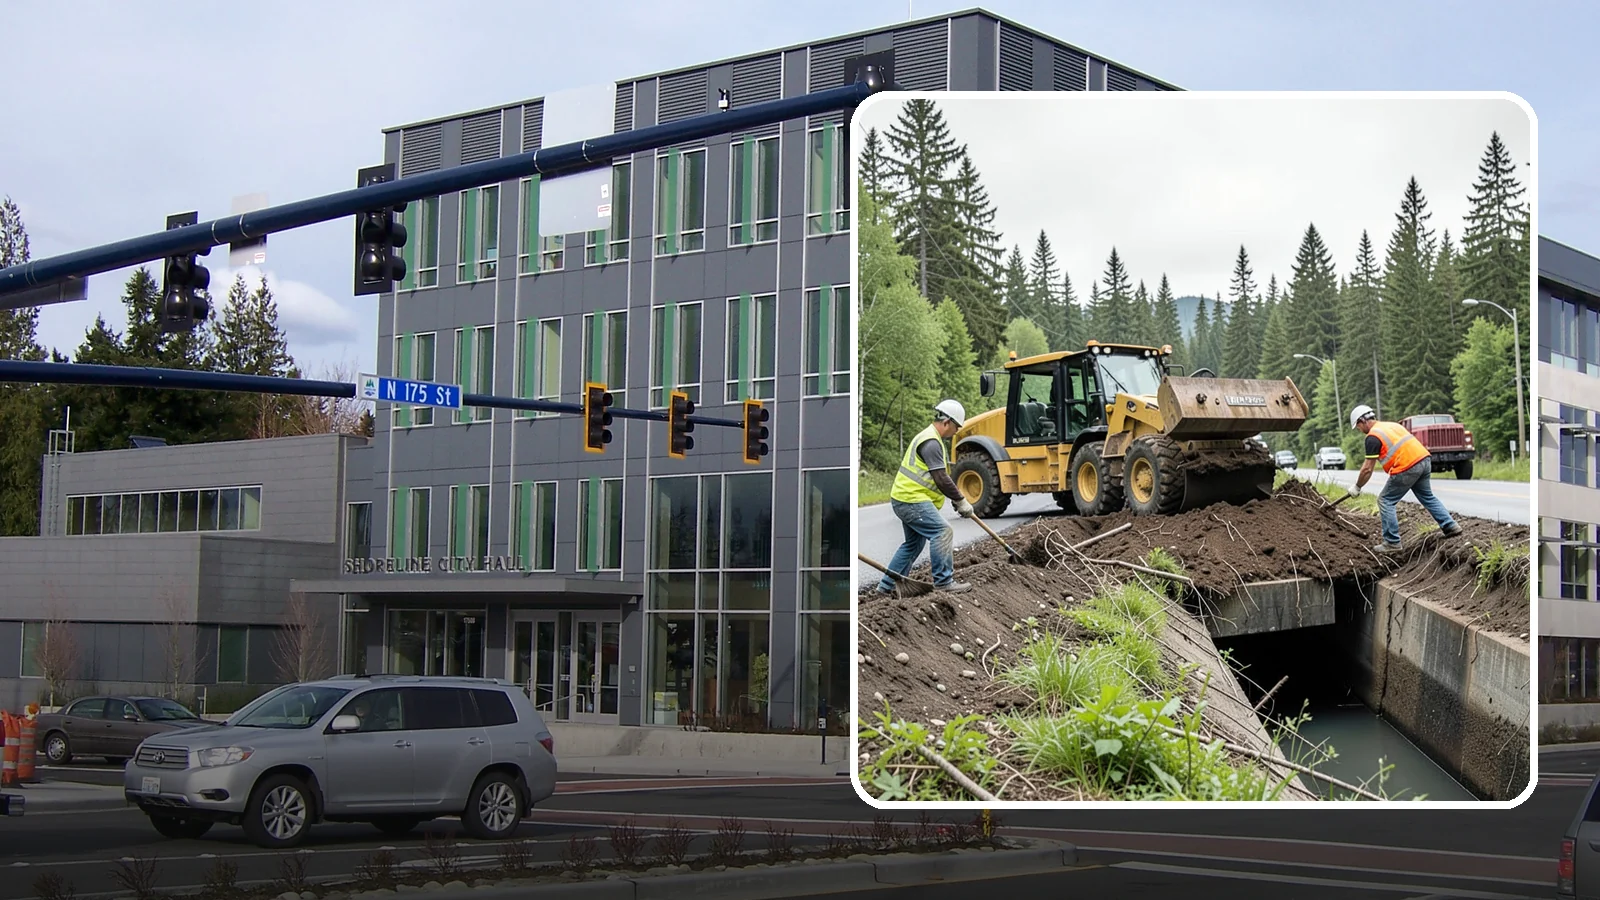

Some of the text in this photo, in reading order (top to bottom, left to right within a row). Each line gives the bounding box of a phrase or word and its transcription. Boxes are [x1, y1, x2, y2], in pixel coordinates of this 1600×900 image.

[387, 380, 451, 406] N 175 St
[343, 556, 525, 574] SHORELINE CITY HALL
